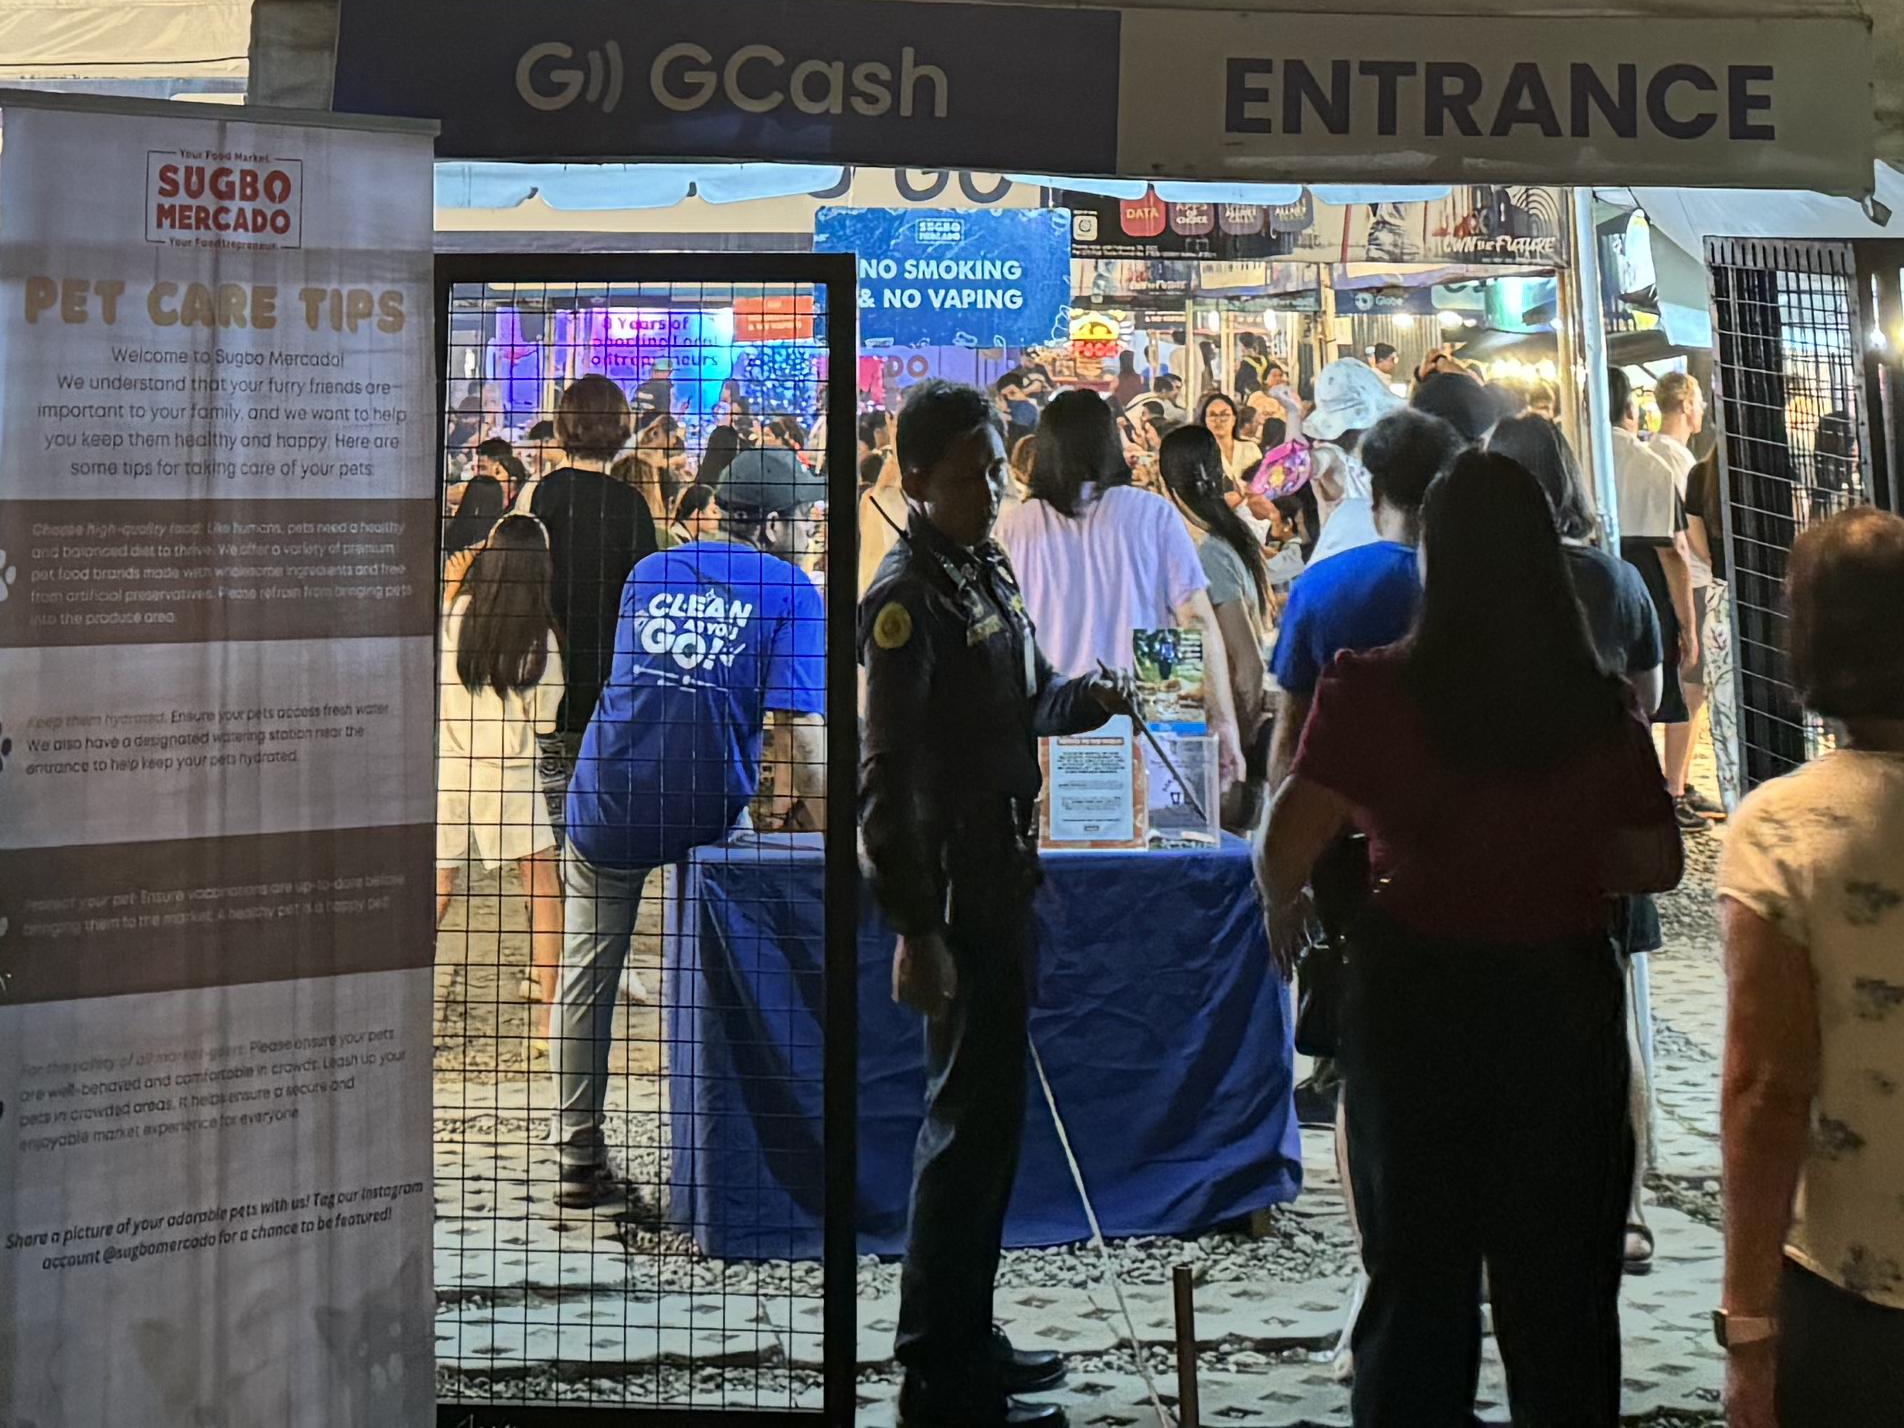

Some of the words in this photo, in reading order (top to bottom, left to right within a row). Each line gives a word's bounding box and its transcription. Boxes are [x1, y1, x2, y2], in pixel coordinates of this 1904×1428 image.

[650, 42, 948, 118] GCash
[1225, 57, 1775, 140] ENTRANCE
[158, 163, 292, 204] SUGBO
[156, 203, 291, 235] MERCADO
[1126, 209, 1159, 220] DATA
[860, 259, 896, 280] NO
[904, 260, 1022, 280] SMOKING
[24, 276, 126, 326] PET
[147, 281, 278, 330] CARE
[298, 287, 406, 334] TIPS
[859, 289, 876, 308] &
[883, 289, 921, 308] NO
[928, 289, 1023, 309] VAPING
[111, 345, 188, 364] Welcome
[193, 347, 211, 364] to
[216, 348, 264, 368] Sugbo
[57, 373, 84, 390] We
[89, 374, 186, 391] understand
[191, 375, 226, 393] that
[230, 379, 263, 396] your
[269, 377, 306, 396] furry
[310, 377, 362, 394] friends
[365, 382, 391, 395] are
[37, 401, 124, 420] important
[129, 404, 146, 418] to
[150, 406, 186, 421] your
[190, 402, 244, 423] family,
[248, 405, 279, 420] and
[284, 410, 307, 421] we
[312, 408, 350, 422] want
[354, 407, 369, 422] to
[372, 406, 407, 425] help
[45, 433, 76, 450] you
[81, 428, 124, 450] keep
[128, 431, 170, 448] them
[175, 430, 237, 451] healthy
[241, 432, 272, 449] and
[335, 433, 369, 449] Here
[373, 436, 399, 449] are
[71, 461, 117, 476] some
[123, 460, 152, 479] tips
[157, 458, 179, 476] for
[185, 458, 236, 479] taking
[241, 462, 275, 476] care
[280, 459, 297, 476] of
[301, 462, 335, 479] your
[649, 593, 752, 627] CLEAN
[641, 618, 724, 670] GO!
[26, 759, 89, 775] entrance
[93, 759, 107, 772] to
[110, 757, 139, 772] help
[141, 756, 173, 772] keep
[176, 755, 207, 771] your
[144, 1075, 171, 1089] and
[6, 1231, 48, 1250] Share
[51, 1231, 60, 1245] a
[62, 1223, 113, 1245] picture
[116, 1217, 131, 1235] of
[132, 1216, 165, 1236] your
[167, 1206, 226, 1227] adorable
[229, 1203, 258, 1222] pets
[261, 1197, 288, 1215] with
[291, 1194, 310, 1210] us!
[314, 1193, 336, 1209] Tag
[338, 1190, 359, 1204] our
[362, 1181, 423, 1200] Instagram
[42, 1250, 100, 1270] account
[103, 1233, 216, 1265] @sugbomercado
[219, 1229, 238, 1245] for
[240, 1230, 248, 1241] a
[251, 1221, 297, 1240] chance
[301, 1219, 315, 1234] to
[317, 1215, 333, 1231] be
[335, 1206, 392, 1229] featured!
